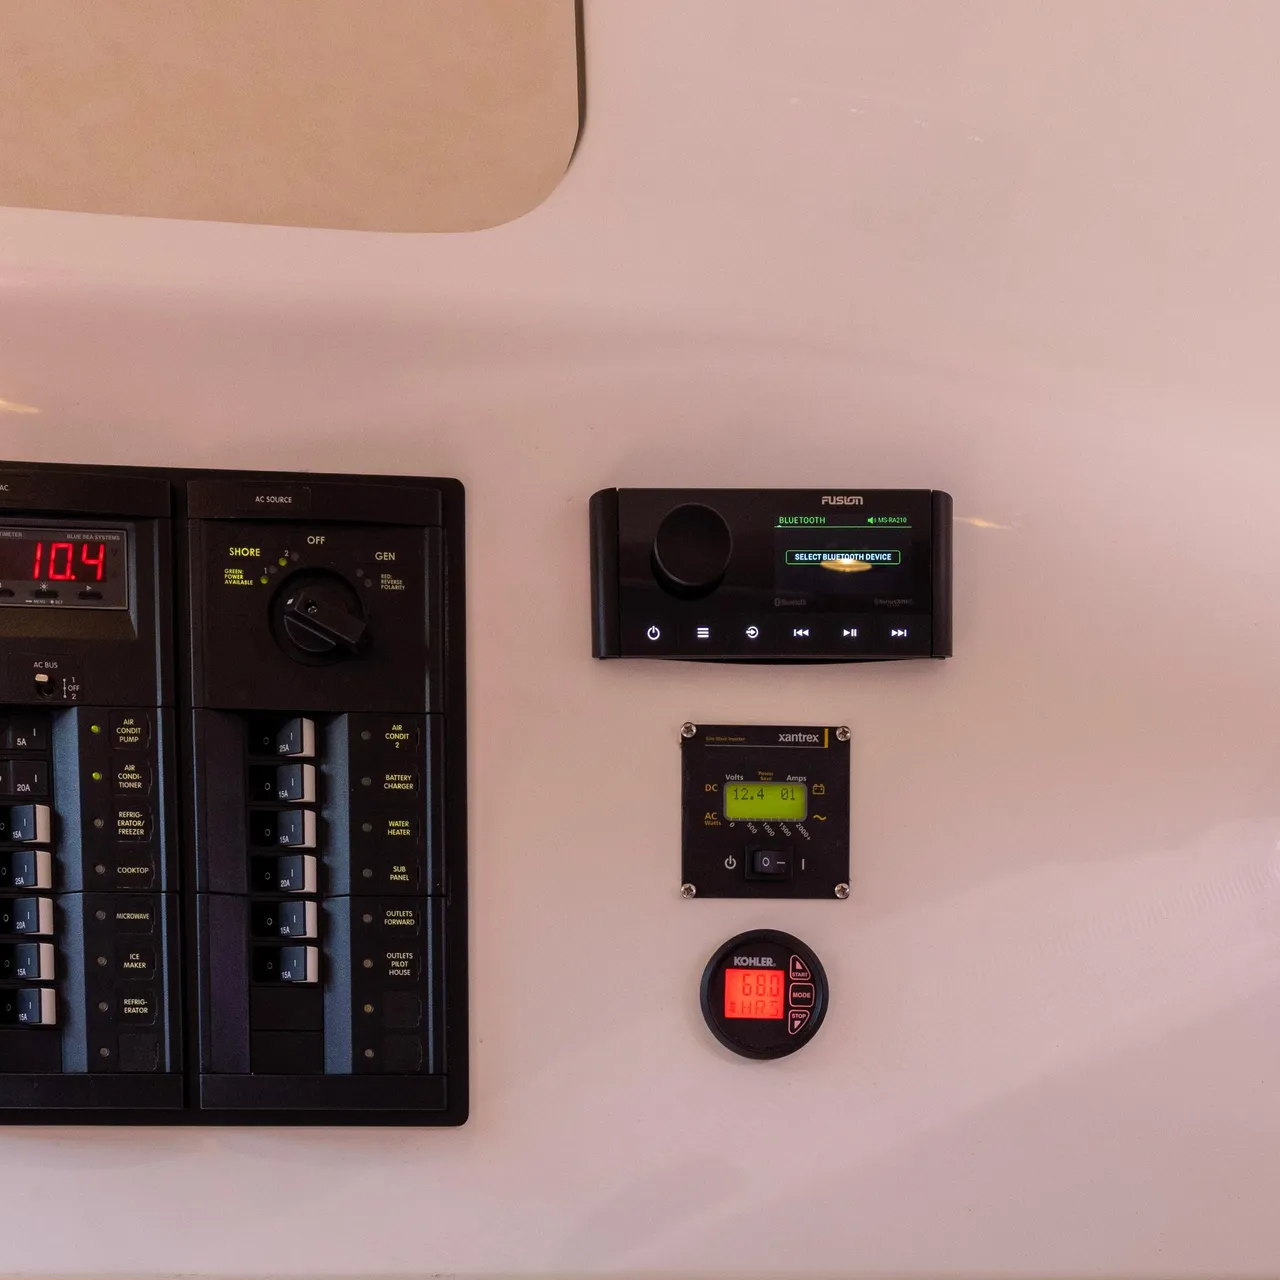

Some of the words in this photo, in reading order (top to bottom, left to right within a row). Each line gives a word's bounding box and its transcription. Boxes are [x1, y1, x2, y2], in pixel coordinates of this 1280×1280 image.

[266, 496, 292, 504] SOURCE
[778, 516, 826, 524] BLUETOOTH
[307, 536, 326, 544] OFF
[229, 547, 261, 557] SHORE
[375, 552, 396, 561] GEN
[794, 553, 821, 561] SELECT
[822, 552, 864, 561] BLUETOOTH
[865, 553, 892, 561] DEVICE
[33, 541, 105, 581] 10.4
[33, 661, 44, 669] AC
[45, 661, 59, 669] BUS
[384, 732, 410, 740] CONDIT
[778, 732, 819, 743] xantrex
[16, 738, 27, 746] 5A
[725, 773, 744, 781] Volts
[786, 774, 807, 783] Amps
[118, 781, 142, 789] TIONER
[383, 782, 414, 790] CHARGER
[704, 784, 718, 792] DC
[733, 787, 765, 800] 12.4
[704, 812, 718, 820] AC
[117, 819, 145, 827] ERATOR/
[387, 828, 411, 836] HEATER
[746, 822, 758, 835] 500
[762, 822, 775, 837] 1000
[778, 822, 792, 837] 1500
[117, 866, 149, 874] COOKTOP
[389, 873, 410, 881] PANEL
[116, 912, 150, 920] MICROWAVE
[384, 918, 415, 926] FORWARD
[733, 956, 774, 967] KOHLER
[792, 991, 811, 999] MODE
